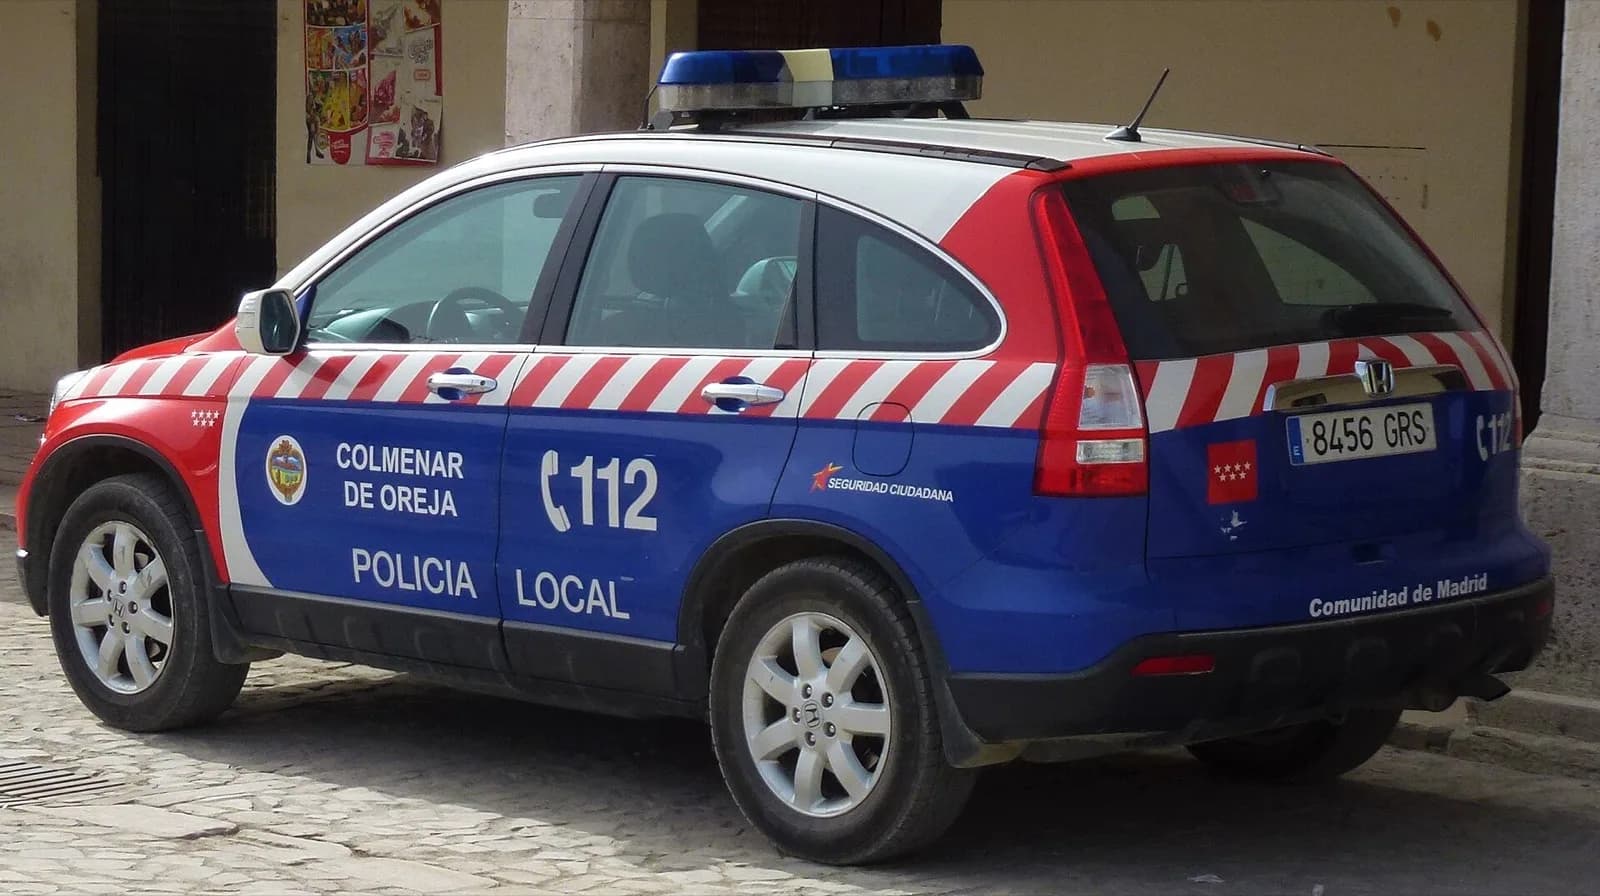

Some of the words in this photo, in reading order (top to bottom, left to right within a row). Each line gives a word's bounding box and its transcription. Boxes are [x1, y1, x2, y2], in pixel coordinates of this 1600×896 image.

[1312, 415, 1373, 456] 8456
[1383, 410, 1426, 448] GRS
[1488, 412, 1512, 455] 112
[336, 442, 464, 480] COLMENAR
[344, 480, 375, 509] DE
[380, 484, 458, 517] OREJA
[570, 455, 658, 532] 112
[827, 477, 888, 494] SEGURIDAD
[889, 483, 954, 503] CIUDADANA
[352, 547, 478, 599] POLICIA
[515, 568, 631, 620] LOCAL
[1309, 586, 1408, 618] Comunidad
[1412, 583, 1433, 603] de
[1437, 572, 1488, 599] Madrid
